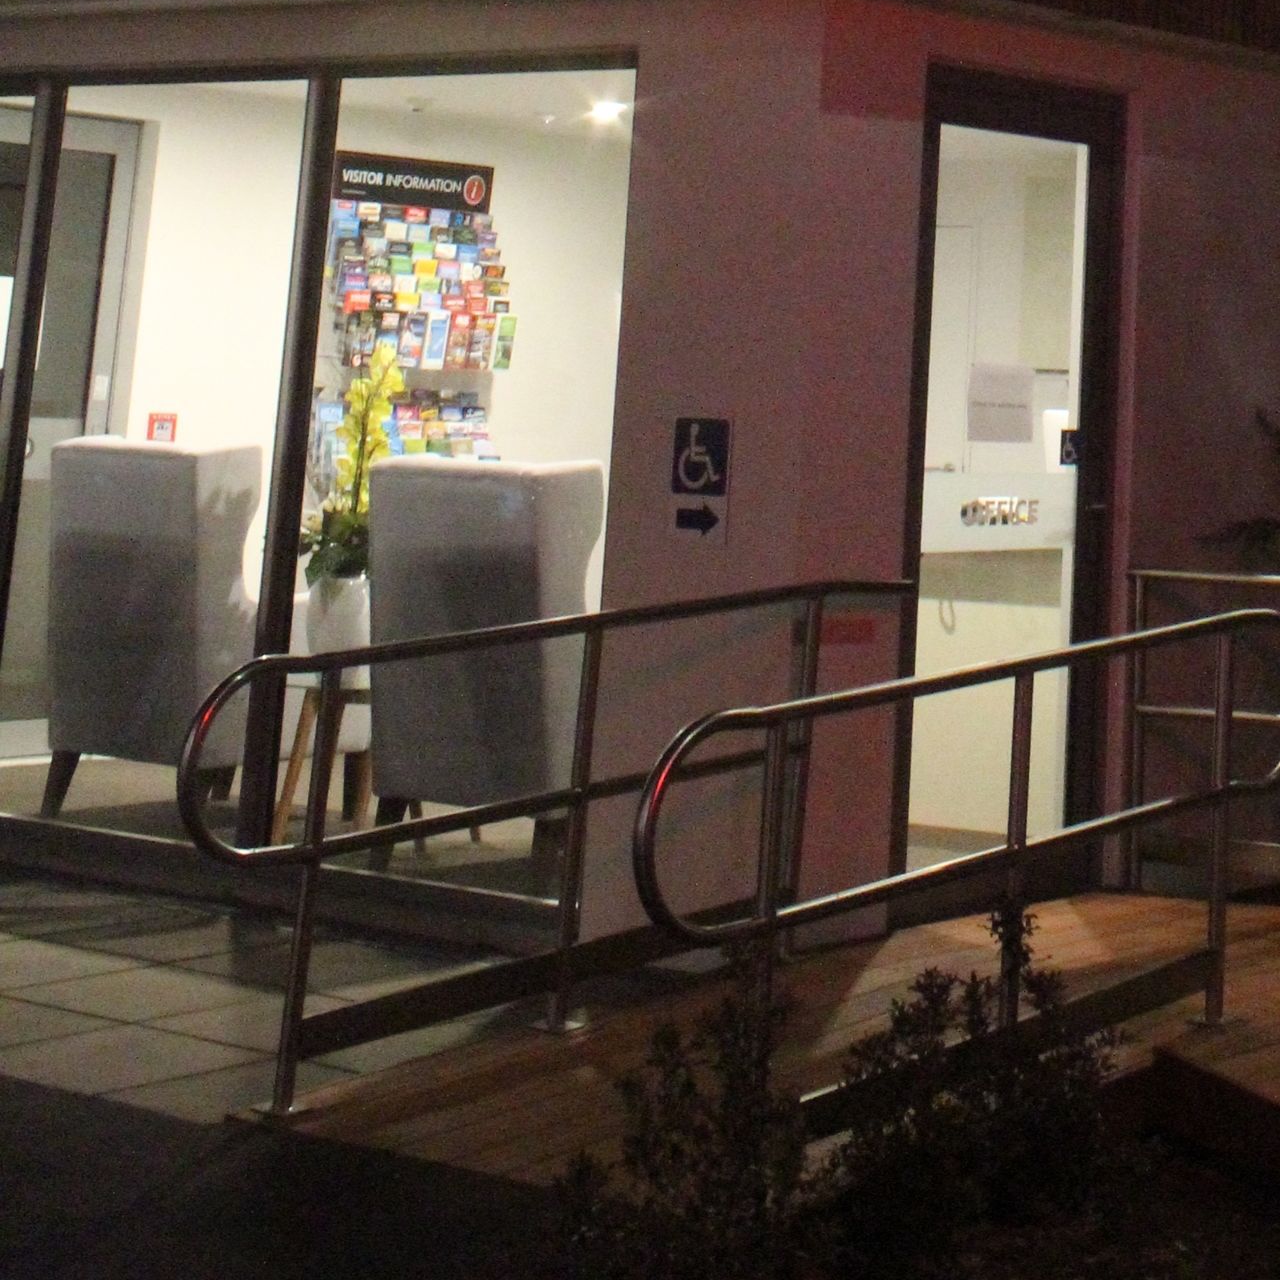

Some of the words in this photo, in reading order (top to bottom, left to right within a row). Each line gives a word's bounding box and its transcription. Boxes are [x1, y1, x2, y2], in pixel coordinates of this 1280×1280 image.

[342, 168, 384, 186] VISITOR
[385, 173, 462, 193] INFORMATION
[961, 498, 1041, 527] OFFICE
